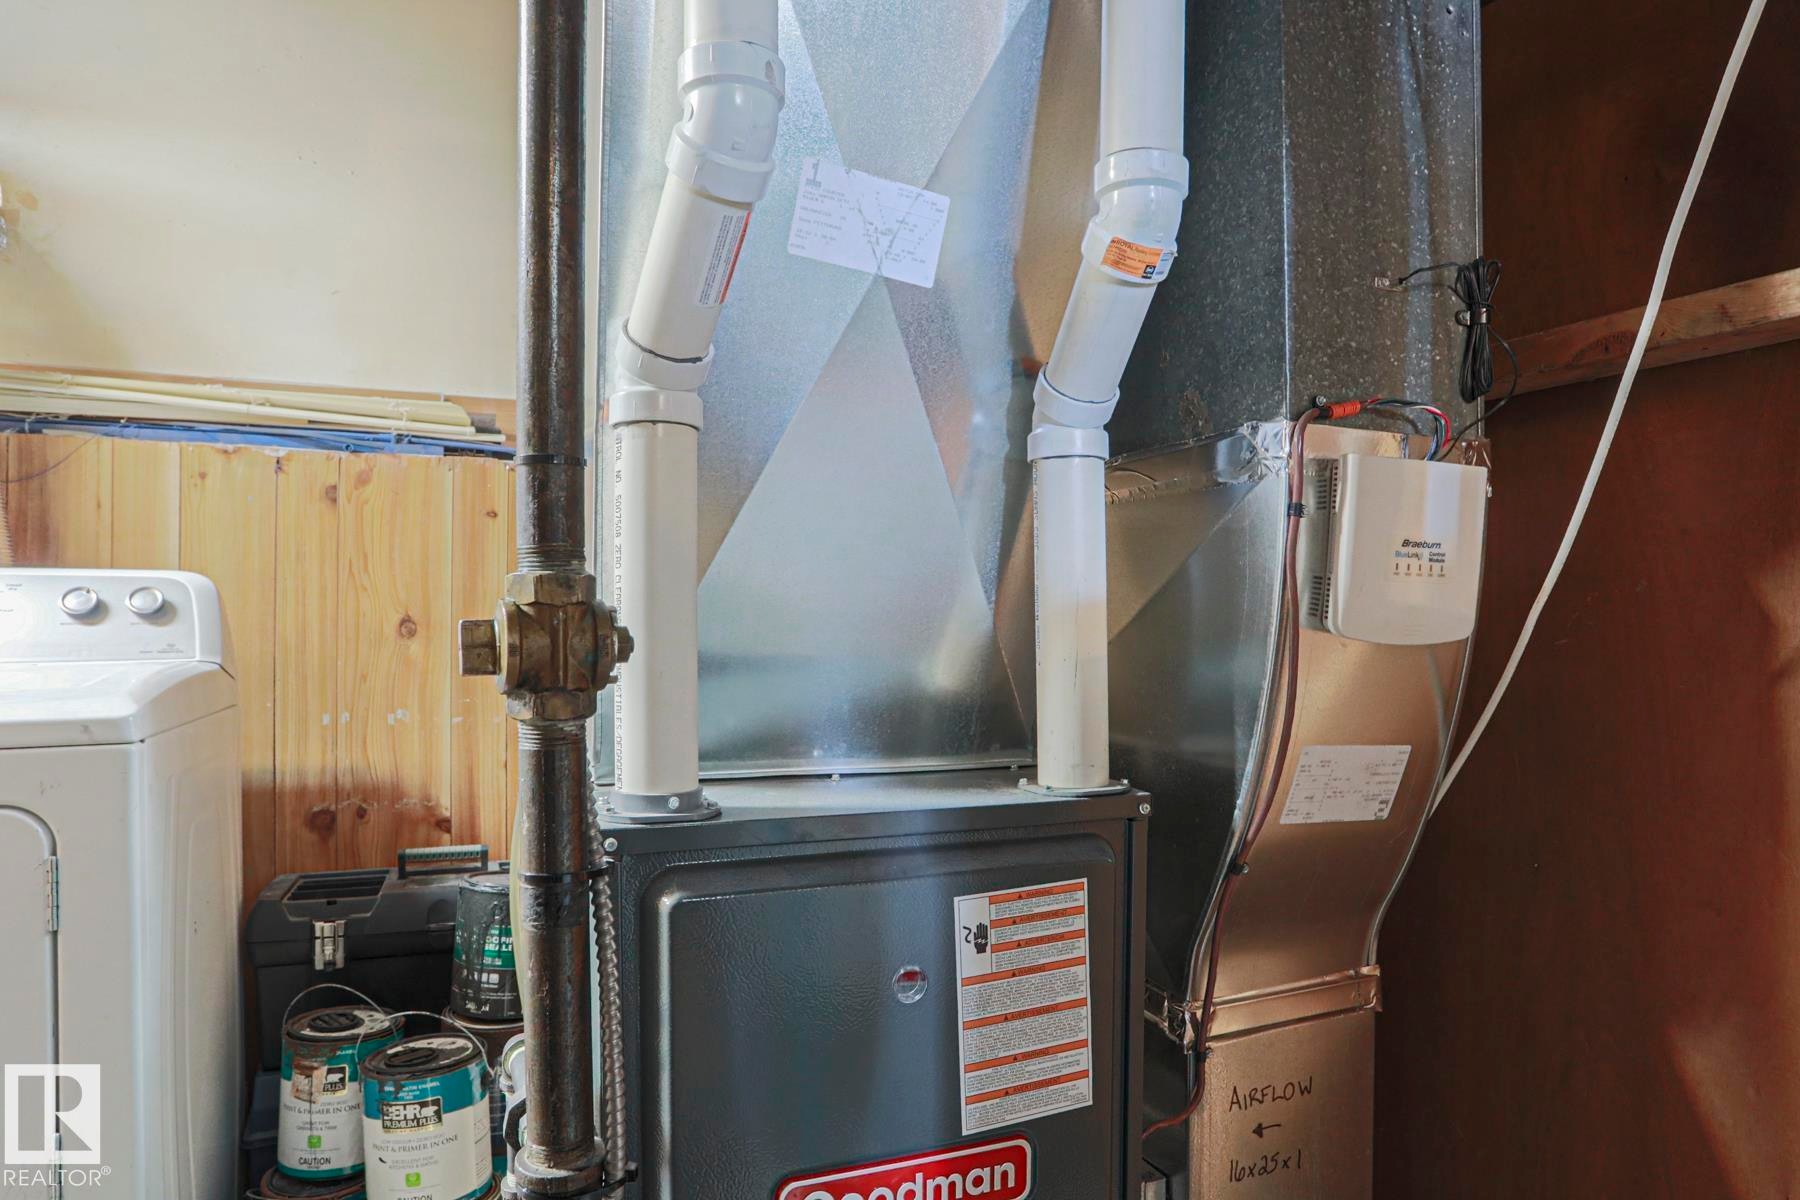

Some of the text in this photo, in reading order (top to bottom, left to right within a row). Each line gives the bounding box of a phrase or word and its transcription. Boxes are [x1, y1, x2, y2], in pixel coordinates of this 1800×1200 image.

[1401, 539, 1442, 549] Braeburn
[485, 936, 513, 944] OOFIN
[484, 944, 513, 952] SEALE
[324, 1082, 344, 1091] PLUS
[1229, 1076, 1313, 1112] AIRFLOW
[383, 1104, 421, 1120] BEHR
[383, 1116, 439, 1128] PREMIUM PLUS
[398, 1144, 429, 1153] PRIMER
[430, 1140, 440, 1149] IN
[441, 1134, 459, 1145] ONE
[298, 1156, 331, 1165] CAUTION
[1229, 1148, 1302, 1183] 16x25x1
[803, 1162, 1016, 1200] odman
